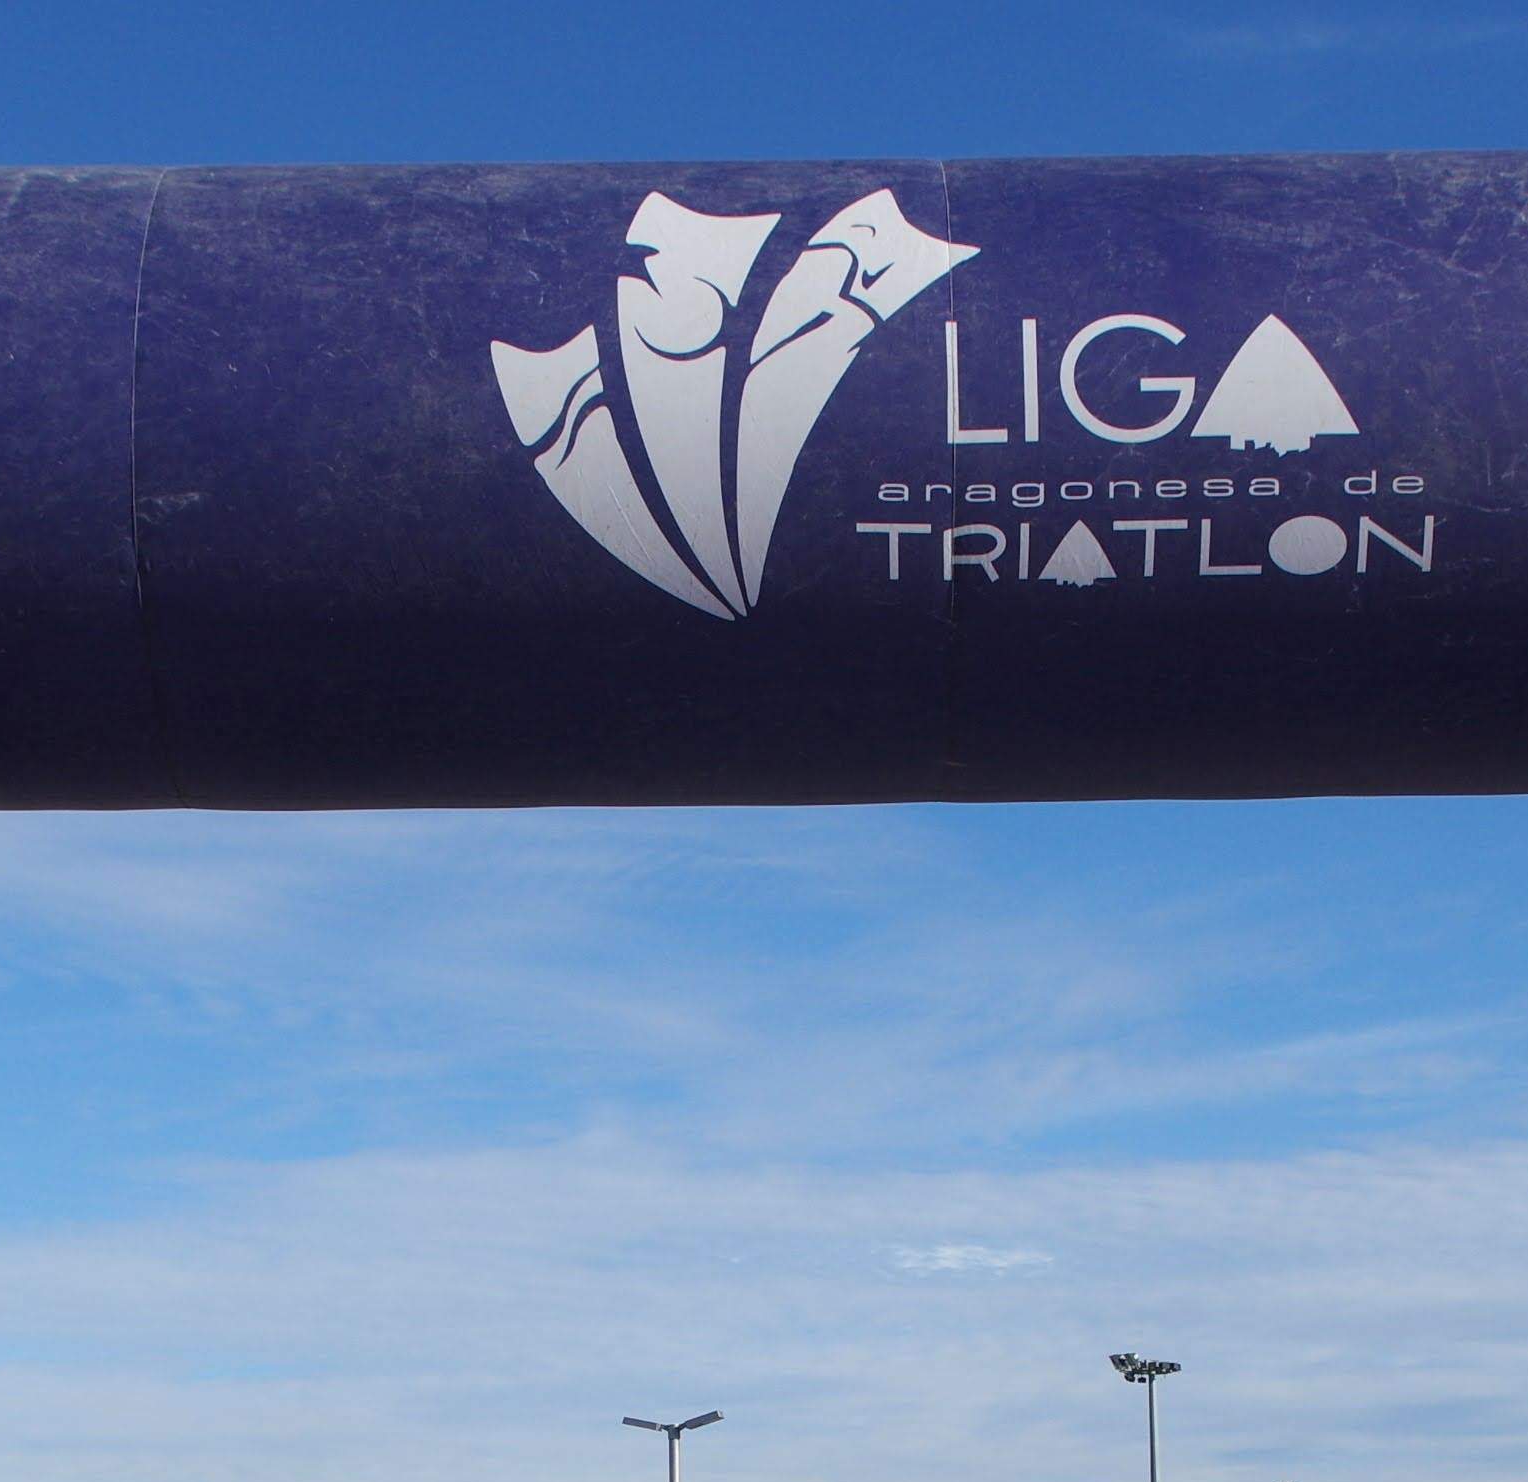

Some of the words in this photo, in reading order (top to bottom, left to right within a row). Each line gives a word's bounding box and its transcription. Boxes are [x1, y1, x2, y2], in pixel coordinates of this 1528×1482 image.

[945, 314, 1360, 457] LIGA
[877, 475, 1281, 508] aragonesa
[1344, 470, 1425, 497] de
[856, 515, 1434, 588] TRIATLON
